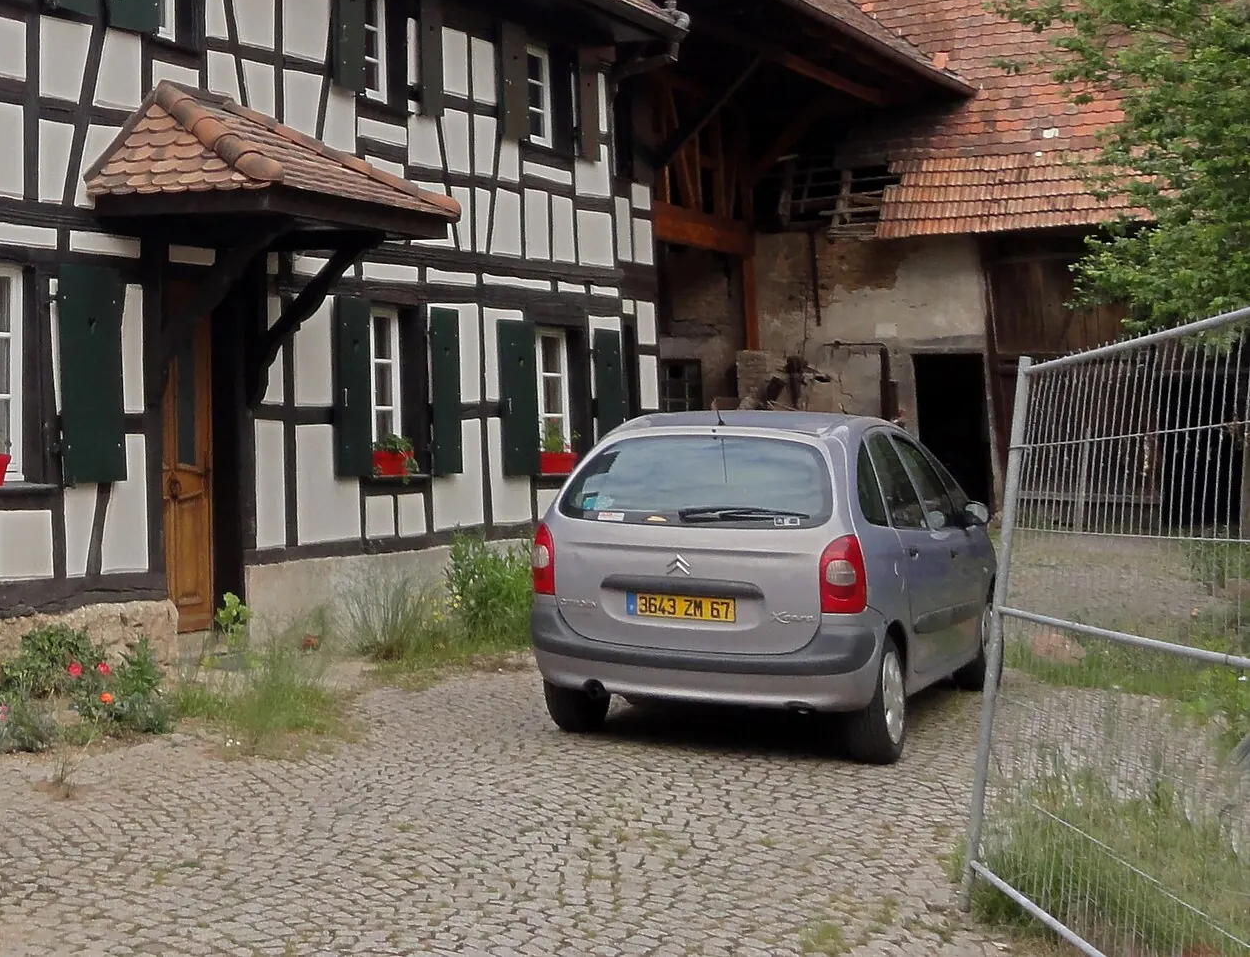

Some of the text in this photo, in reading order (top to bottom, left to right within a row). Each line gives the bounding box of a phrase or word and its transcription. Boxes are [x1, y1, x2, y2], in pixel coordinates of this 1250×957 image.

[638, 596, 676, 615] 3643
[683, 599, 703, 617] ZM
[710, 601, 730, 619] 67
